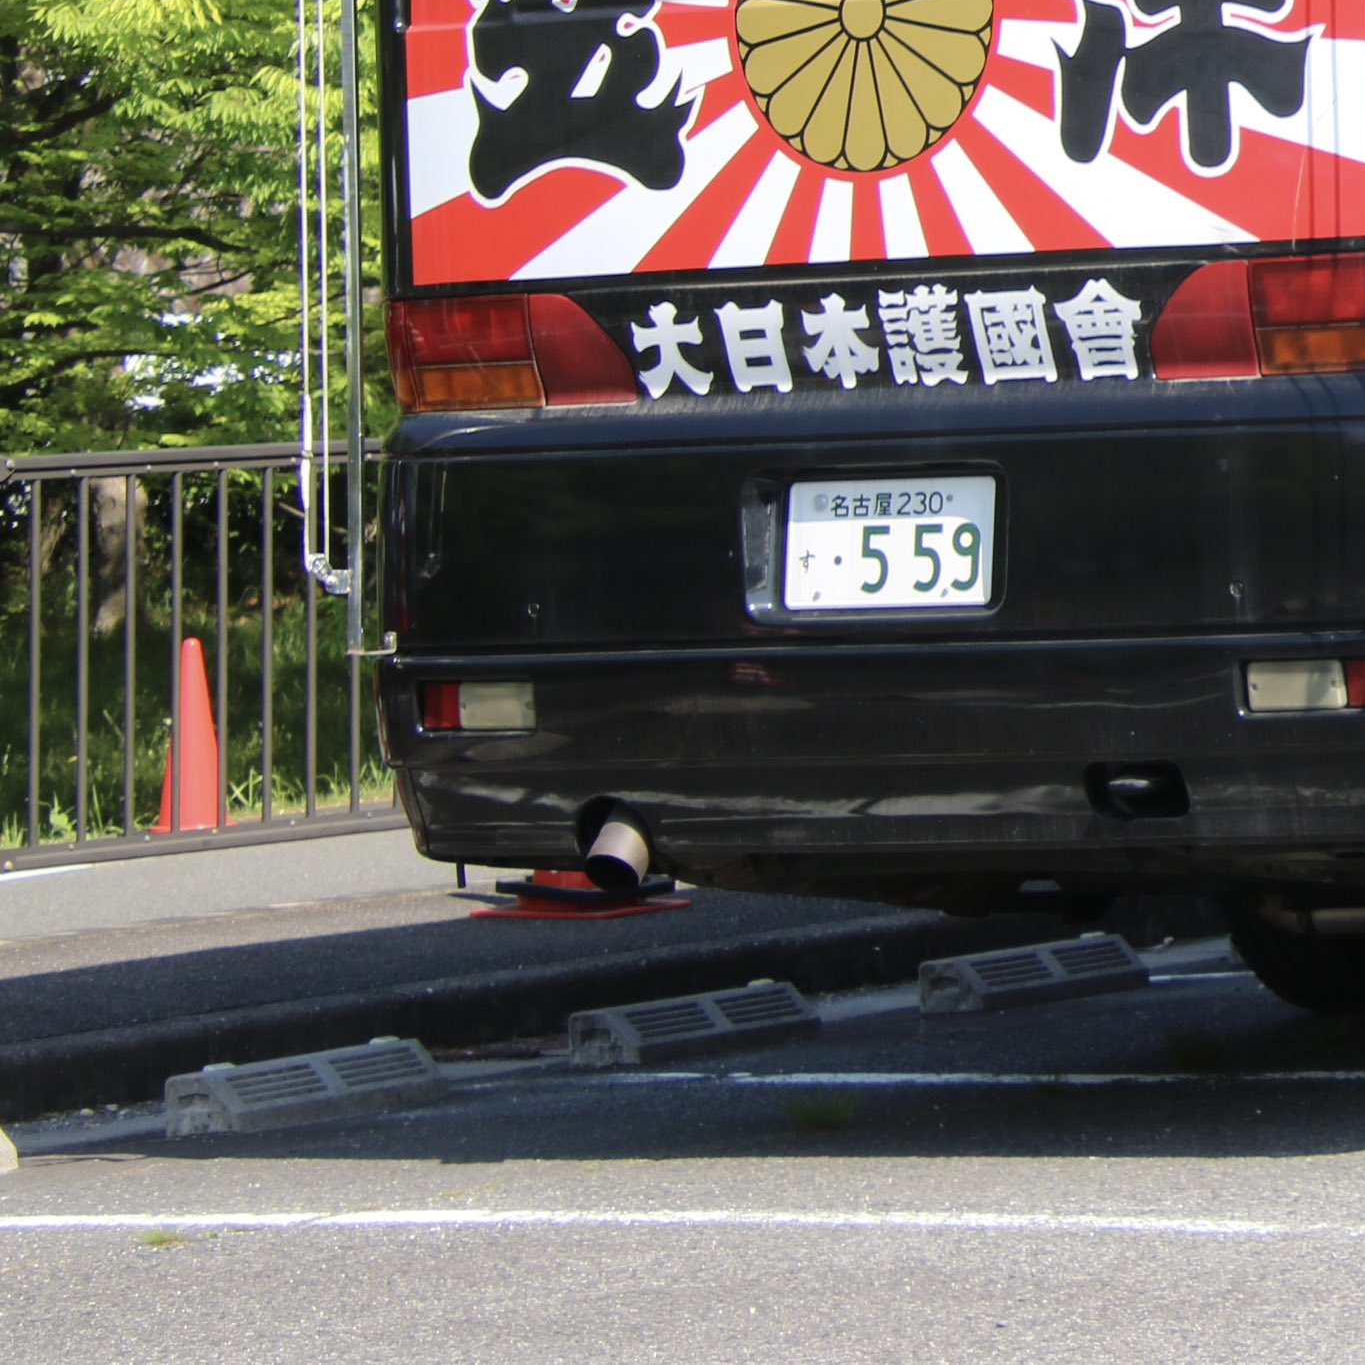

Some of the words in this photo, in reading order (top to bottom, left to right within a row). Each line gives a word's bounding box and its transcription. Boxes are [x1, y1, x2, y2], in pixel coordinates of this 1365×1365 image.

[630, 277, 1142, 400] 大日本護國會
